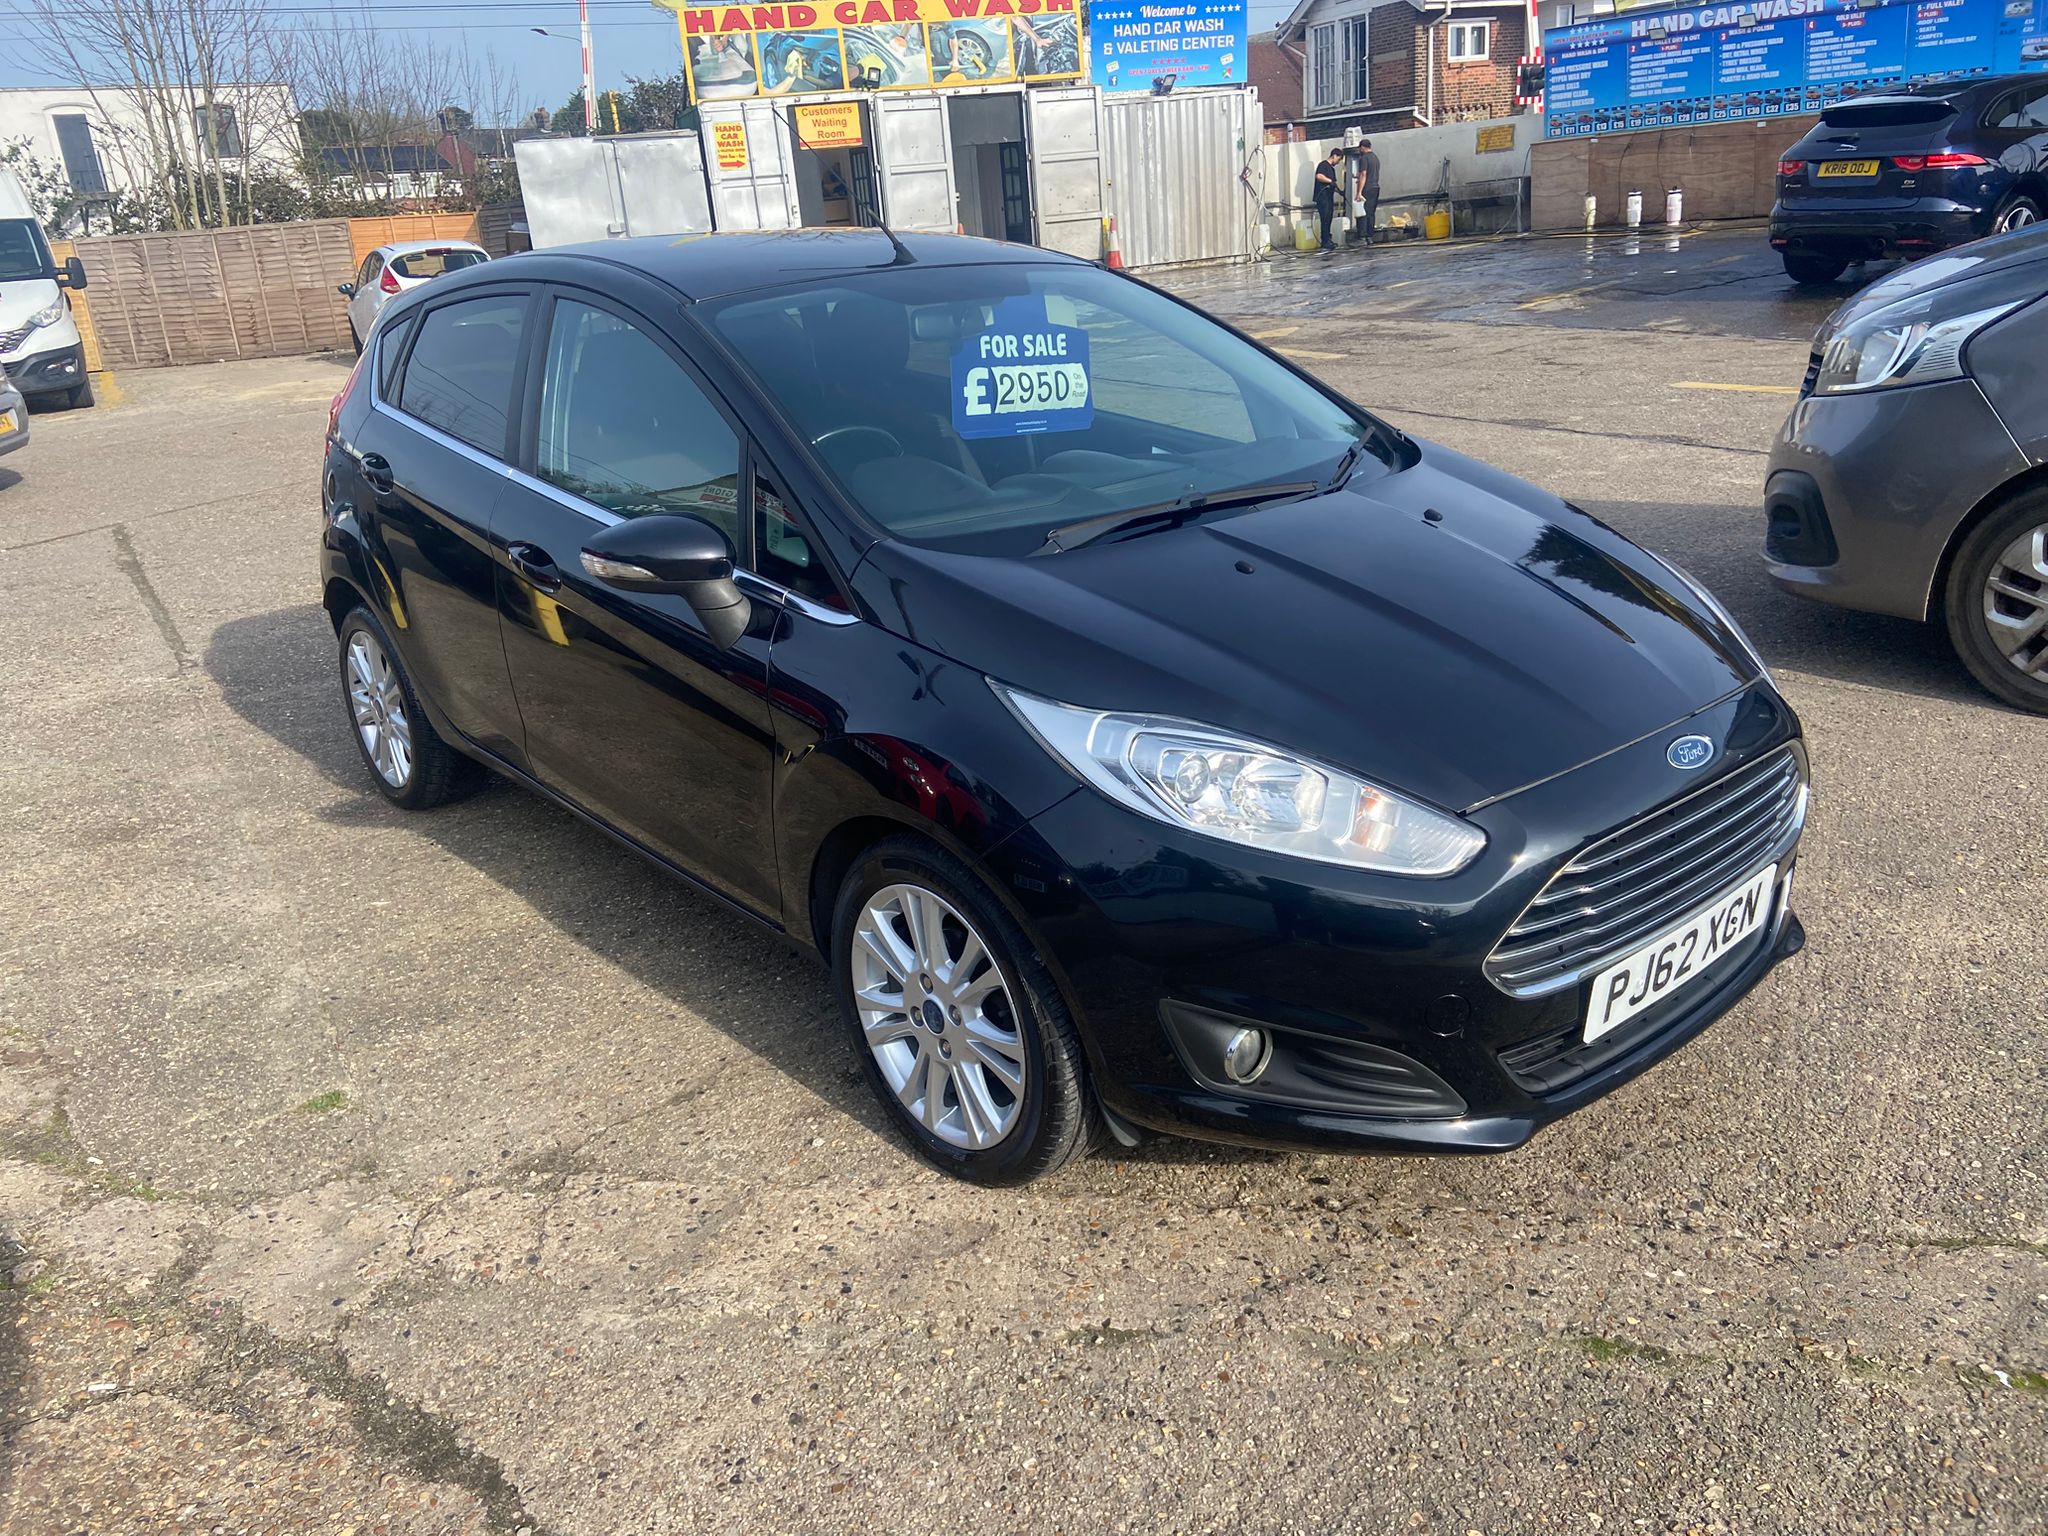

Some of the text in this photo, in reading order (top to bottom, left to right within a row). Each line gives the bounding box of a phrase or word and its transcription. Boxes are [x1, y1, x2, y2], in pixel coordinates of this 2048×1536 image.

[1139, 4, 1197, 18] Welcome to
[1926, 1, 1943, 9] FULL
[683, 0, 1074, 34] HAND CAR WASH
[1631, 13, 1694, 38] HAND
[1700, 6, 1746, 28] CAR
[1751, 0, 1824, 20] WASH
[1113, 18, 1224, 38] HAND CAR WASH
[1103, 35, 1235, 56] & VALETING CENTER
[801, 105, 853, 117] Customers
[812, 117, 848, 128] Waiting
[715, 125, 743, 133] HAND
[817, 130, 845, 139] Room
[720, 132, 739, 140] CAR
[716, 140, 744, 148] WASH
[1824, 162, 1873, 174] KR18 ODJ
[979, 333, 1067, 359] FOR SALE
[1072, 390, 1086, 398] Road
[1678, 742, 1705, 764] Ford
[1603, 928, 1698, 1024] PJ62
